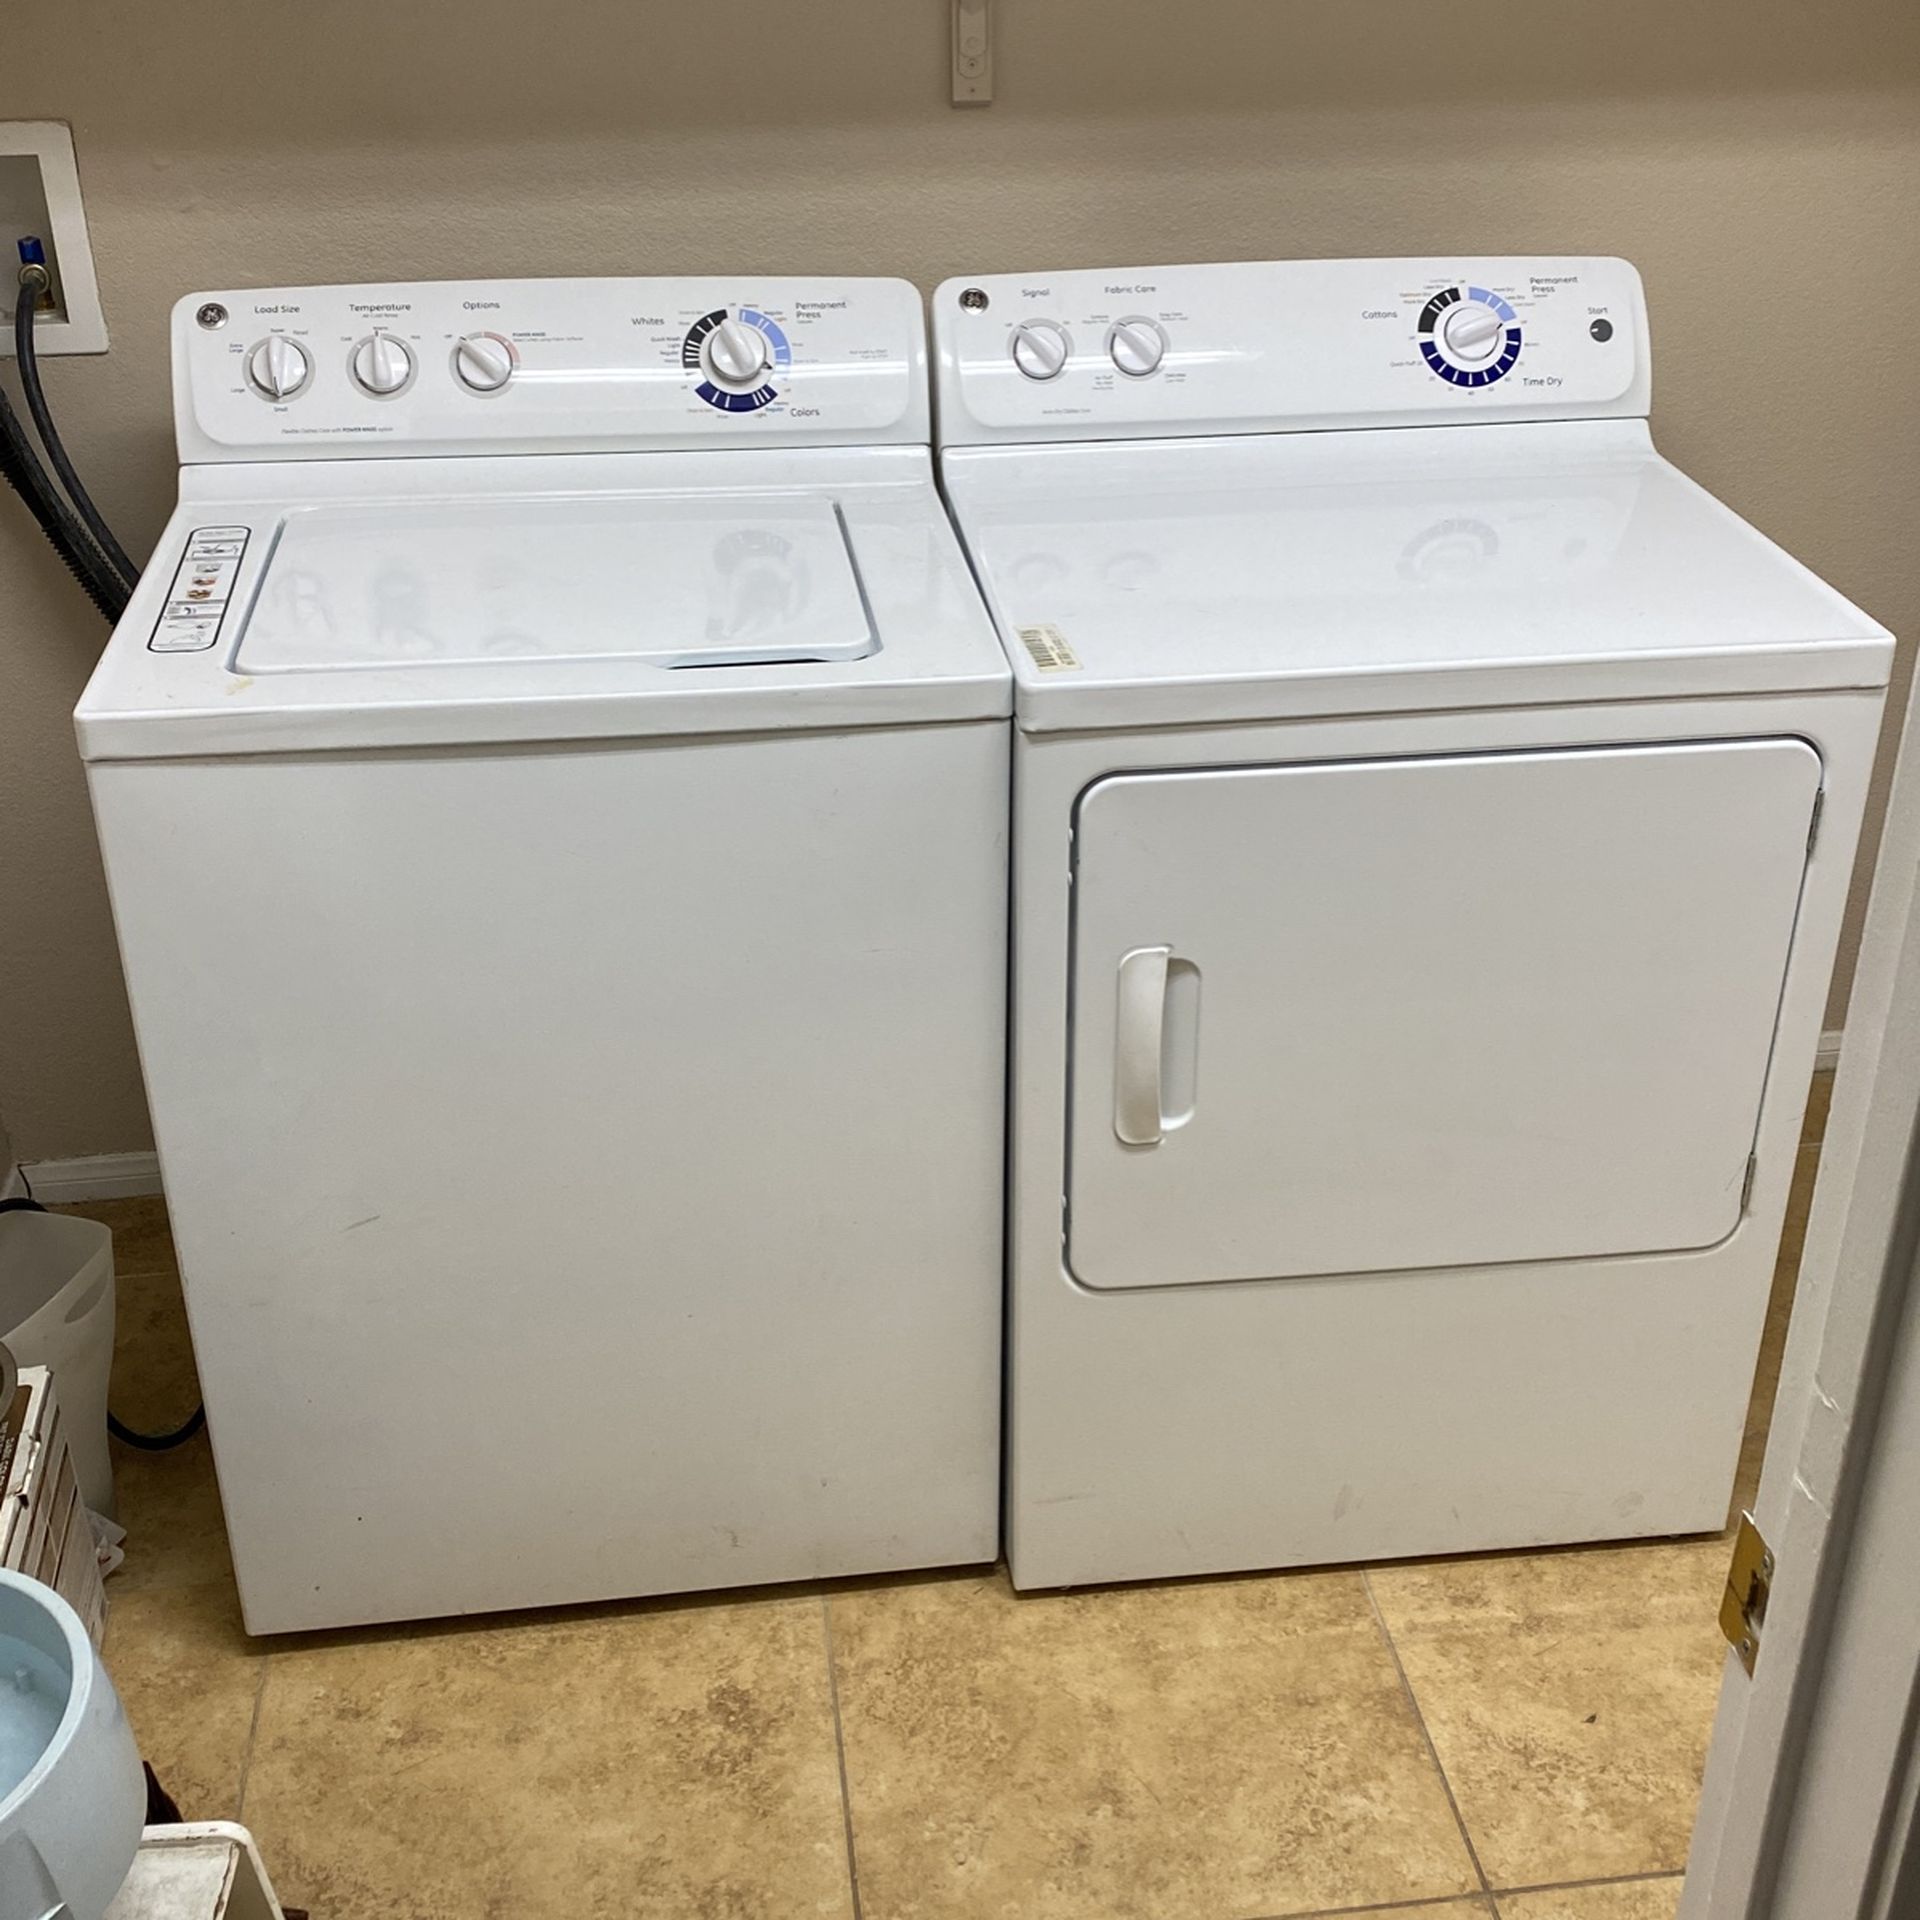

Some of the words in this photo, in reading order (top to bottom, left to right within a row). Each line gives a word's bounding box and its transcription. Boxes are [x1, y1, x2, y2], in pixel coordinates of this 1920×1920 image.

[1530, 276, 1578, 285] Permanent
[1021, 288, 1050, 298] Signal
[1104, 286, 1132, 294] Fabric
[1135, 285, 1156, 293] Care
[254, 305, 279, 314] Load
[281, 305, 300, 314] Size
[349, 303, 412, 313] Temperature
[463, 301, 501, 311] Options
[795, 302, 846, 310] Permanent
[796, 311, 821, 319] Press
[1361, 310, 1398, 319] Cottons
[1588, 307, 1608, 315] Start
[631, 317, 664, 325] Whites
[1523, 377, 1545, 386] Time
[1546, 377, 1563, 387] Dry
[790, 408, 820, 417] Colors
